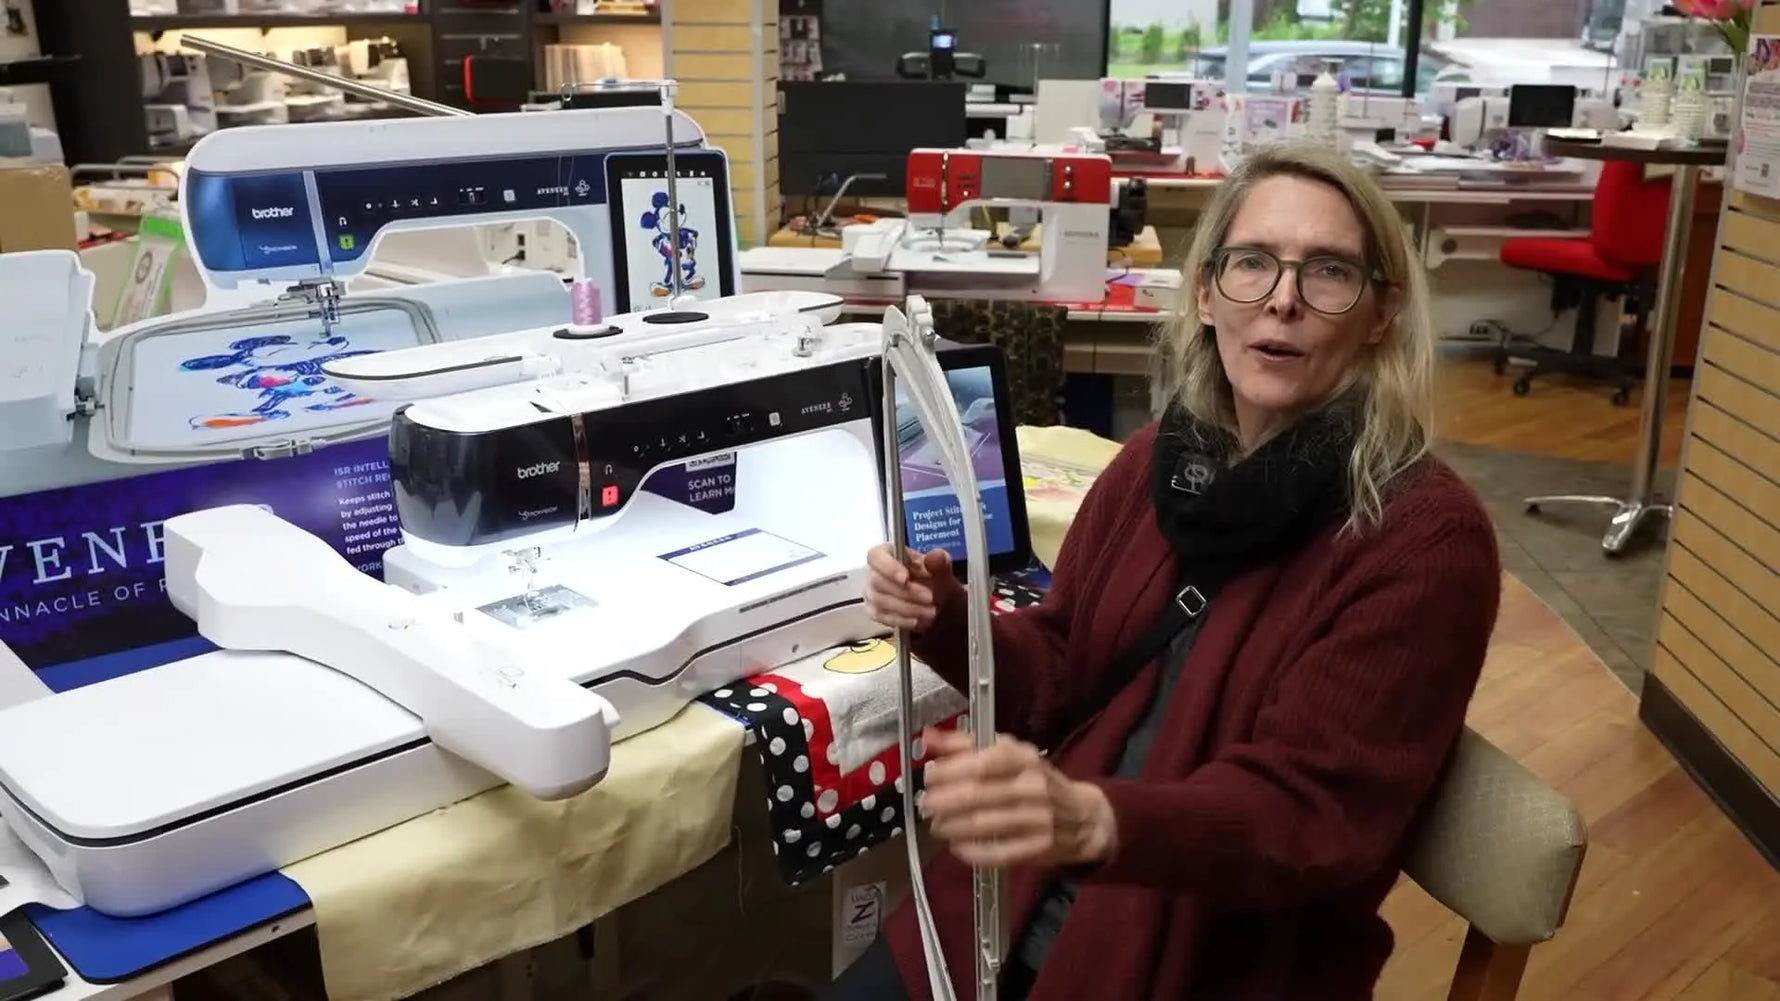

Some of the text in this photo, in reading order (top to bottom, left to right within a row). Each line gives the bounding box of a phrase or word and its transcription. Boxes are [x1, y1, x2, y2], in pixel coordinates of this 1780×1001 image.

[251, 207, 294, 219] brother
[334, 461, 389, 476] ISR INTELL
[517, 461, 560, 479] brother
[336, 475, 373, 489] STITCH
[688, 474, 731, 491] SCAN TO
[339, 491, 391, 506] Keeps stitch
[689, 488, 723, 503] LEARN
[341, 503, 393, 519] by adjusting
[913, 504, 961, 520] Project Stit
[342, 514, 398, 530] the needle to
[914, 517, 961, 532] Designs for
[345, 526, 398, 543] speed of the
[916, 528, 960, 542] Placement
[0, 520, 166, 584] ENE
[346, 545, 361, 555] fed
[362, 539, 397, 552] through
[358, 561, 383, 572] ORK
[114, 582, 145, 601] OF
